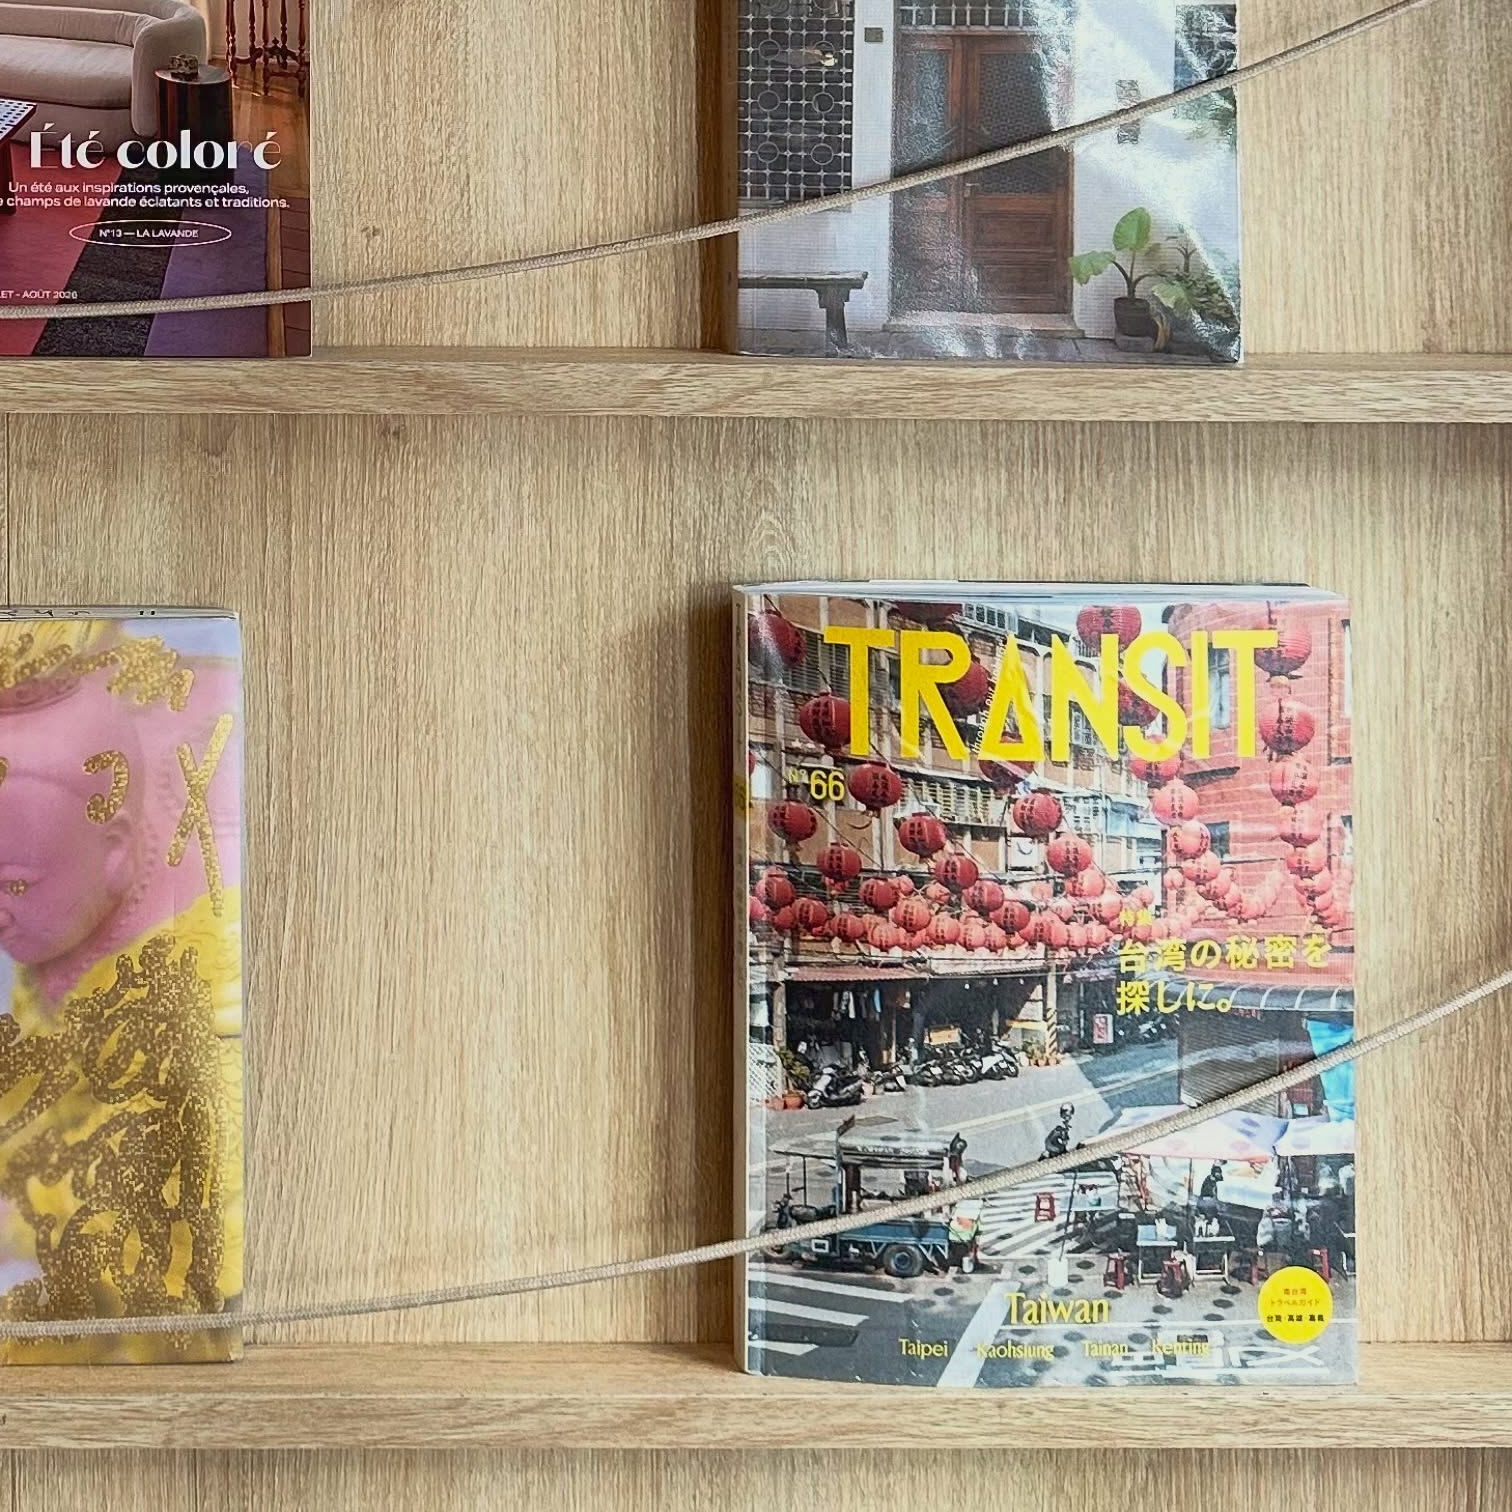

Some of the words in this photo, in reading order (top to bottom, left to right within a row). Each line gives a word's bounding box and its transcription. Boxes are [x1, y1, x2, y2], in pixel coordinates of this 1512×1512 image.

[31, 123, 106, 170] Été
[117, 129, 282, 170] coloré
[8, 181, 28, 193] Un
[31, 181, 52, 193] été
[55, 184, 80, 193] aux
[82, 181, 162, 196] inspirations
[164, 181, 250, 197] provençales,
[6, 195, 61, 209] champs
[64, 196, 82, 207] de
[84, 196, 137, 208] lavande
[139, 195, 203, 208] éclatants
[205, 197, 220, 208] et
[222, 196, 290, 208] traditions.
[136, 228, 149, 238] LA
[152, 228, 199, 238] LAVANDE
[22, 288, 51, 299] AOÛT
[824, 627, 1277, 762] TRANSIT
[1118, 934, 1332, 974] 台湾の秘密を
[1117, 981, 1233, 1016] 探しに。
[899, 1338, 949, 1358] Taipei
[977, 1339, 1054, 1360] Kaohsiung
[1083, 1339, 1129, 1358] Tainan
[1151, 1338, 1210, 1358] Kenting
